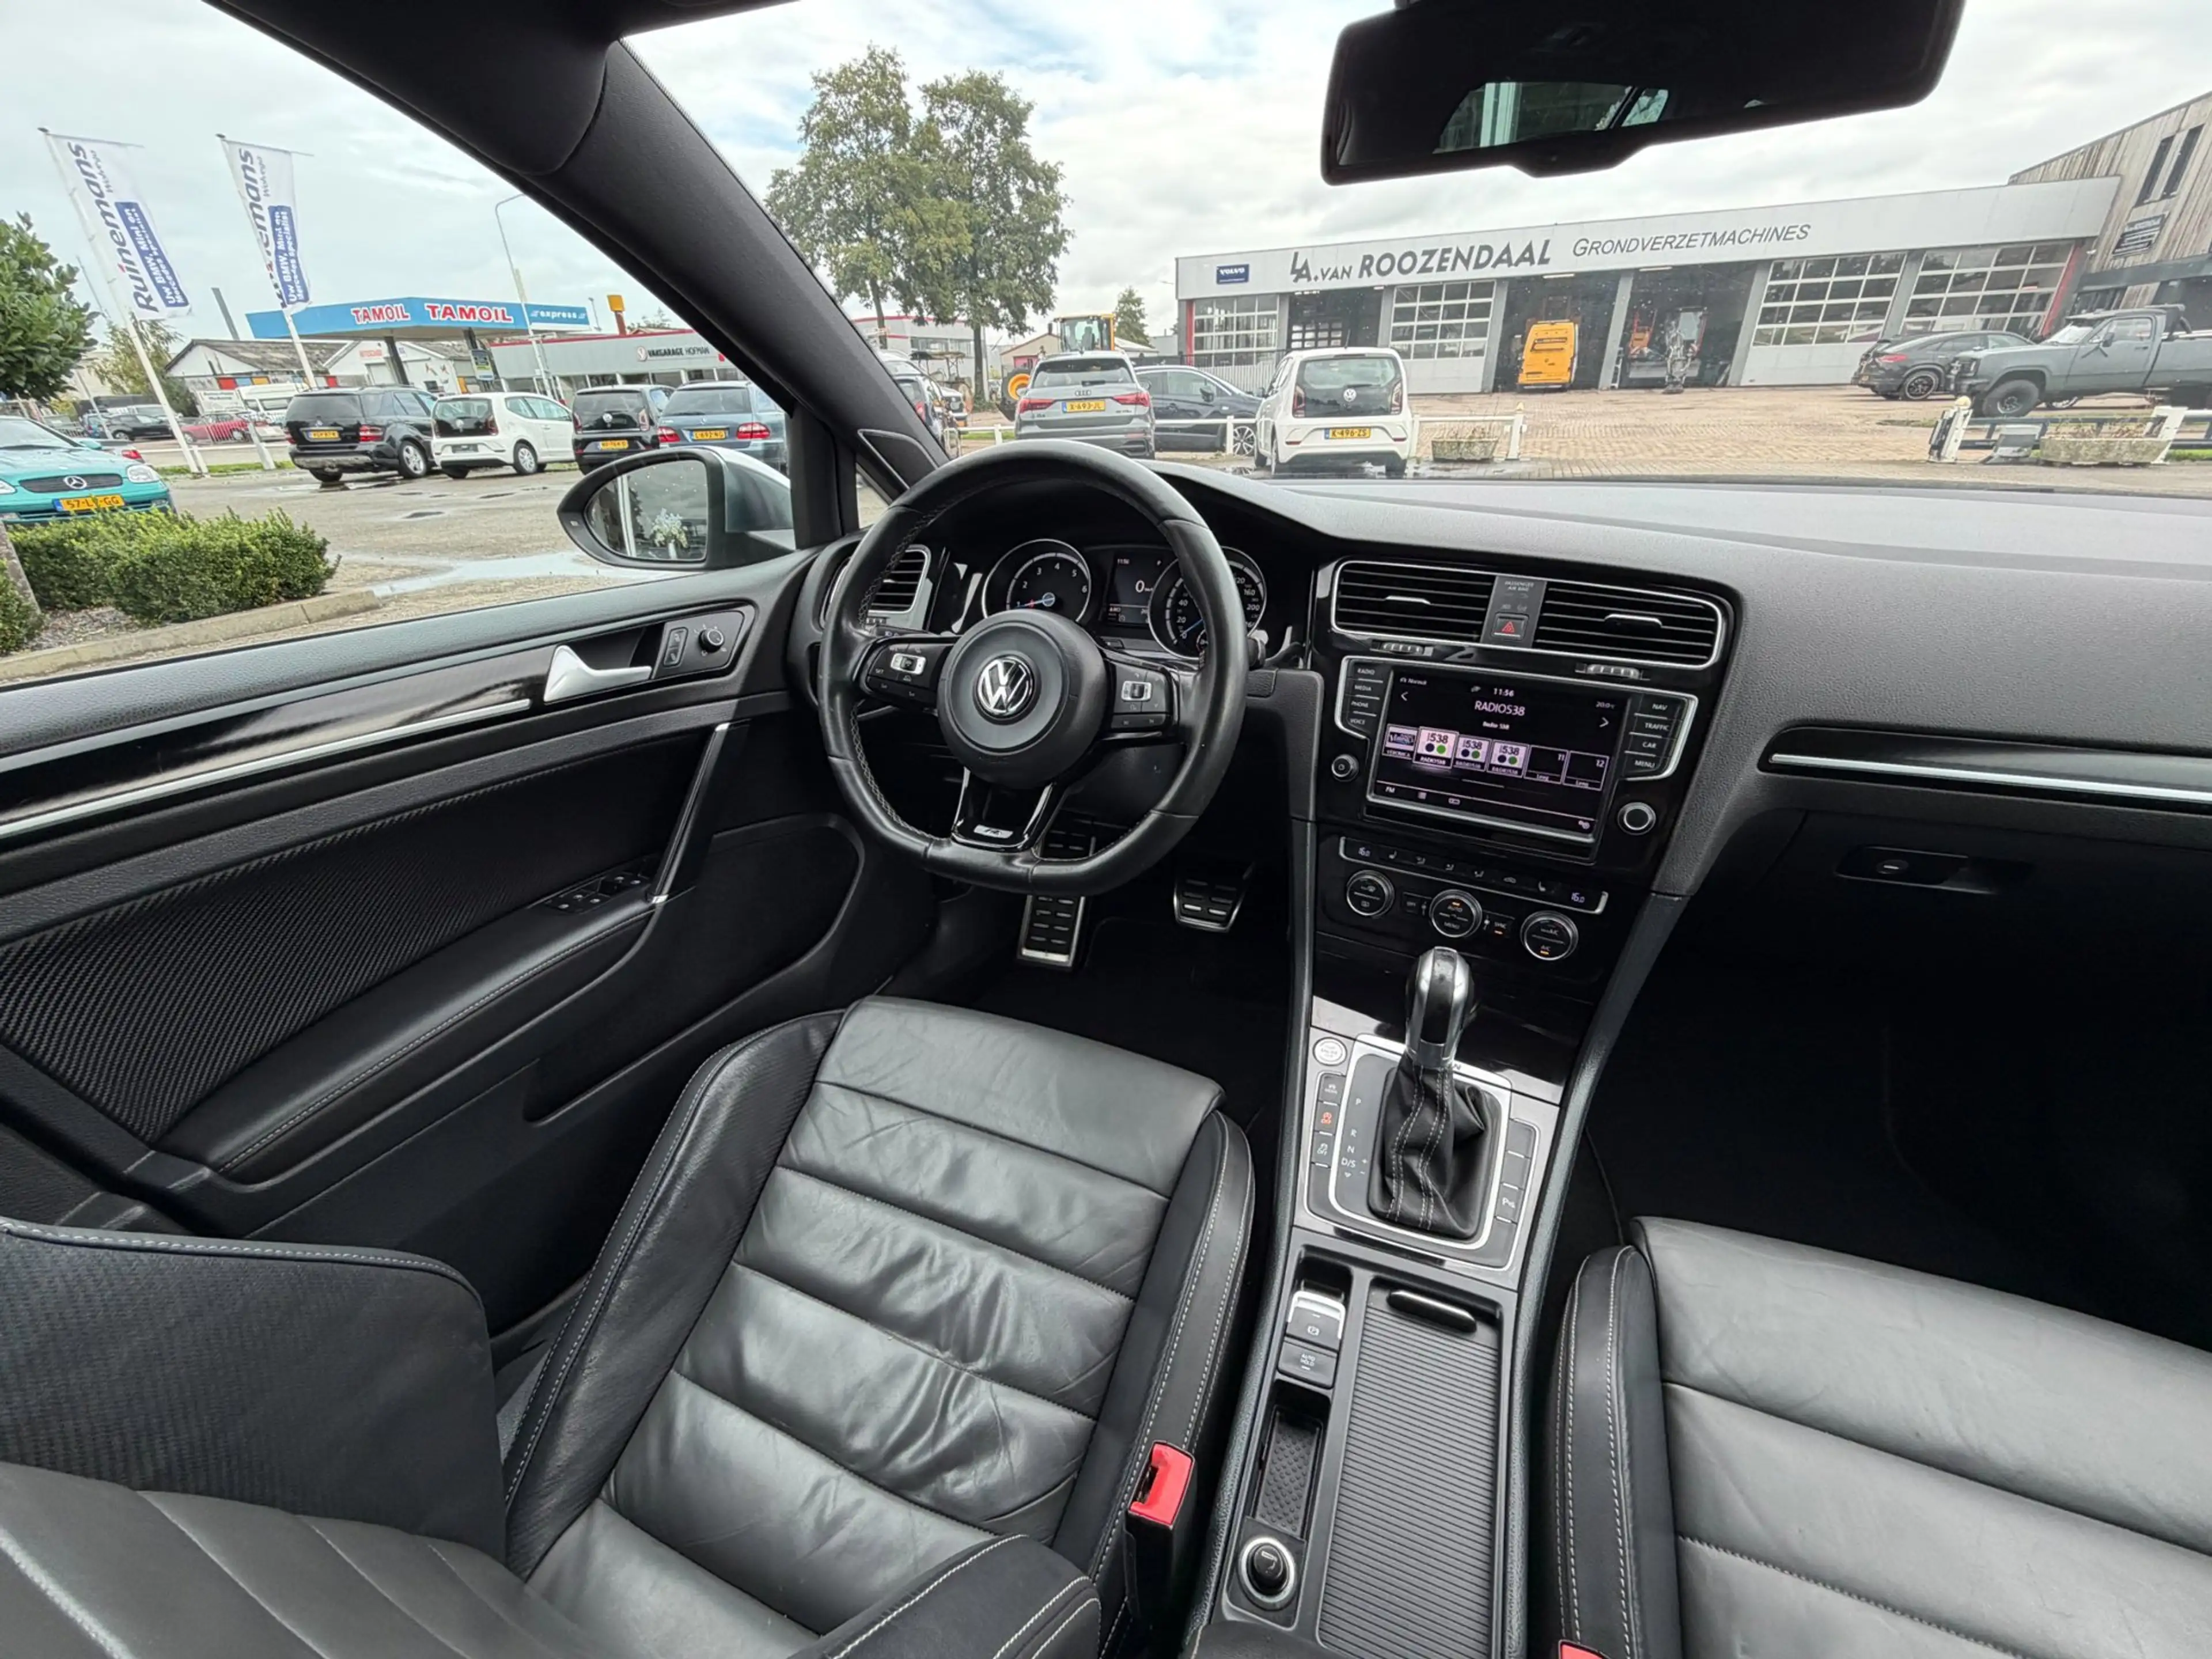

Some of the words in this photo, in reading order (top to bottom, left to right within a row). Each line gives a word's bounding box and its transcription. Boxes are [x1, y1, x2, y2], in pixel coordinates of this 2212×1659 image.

[68, 142, 159, 313] Ruinemans
[130, 225, 149, 251] Mini
[1358, 239, 1551, 278] ROOZENDAAL
[145, 255, 165, 284] BMW,
[162, 286, 176, 304] Uw
[289, 285, 297, 302] Uw
[353, 305, 410, 323] TAMOIL
[425, 305, 513, 322] TAMOIL
[540, 310, 577, 320] express
[1037, 567, 1042, 575] 3
[1071, 569, 1077, 577] 5
[1022, 581, 1028, 589] 2
[1081, 585, 1088, 593] 6
[1135, 579, 1145, 593] 0
[1494, 687, 1514, 697] 11:56
[1635, 760, 1655, 768] MENU
[1350, 1128, 1358, 1137] R
[1347, 1145, 1355, 1154] N
[1341, 1157, 1357, 1168] D/S
